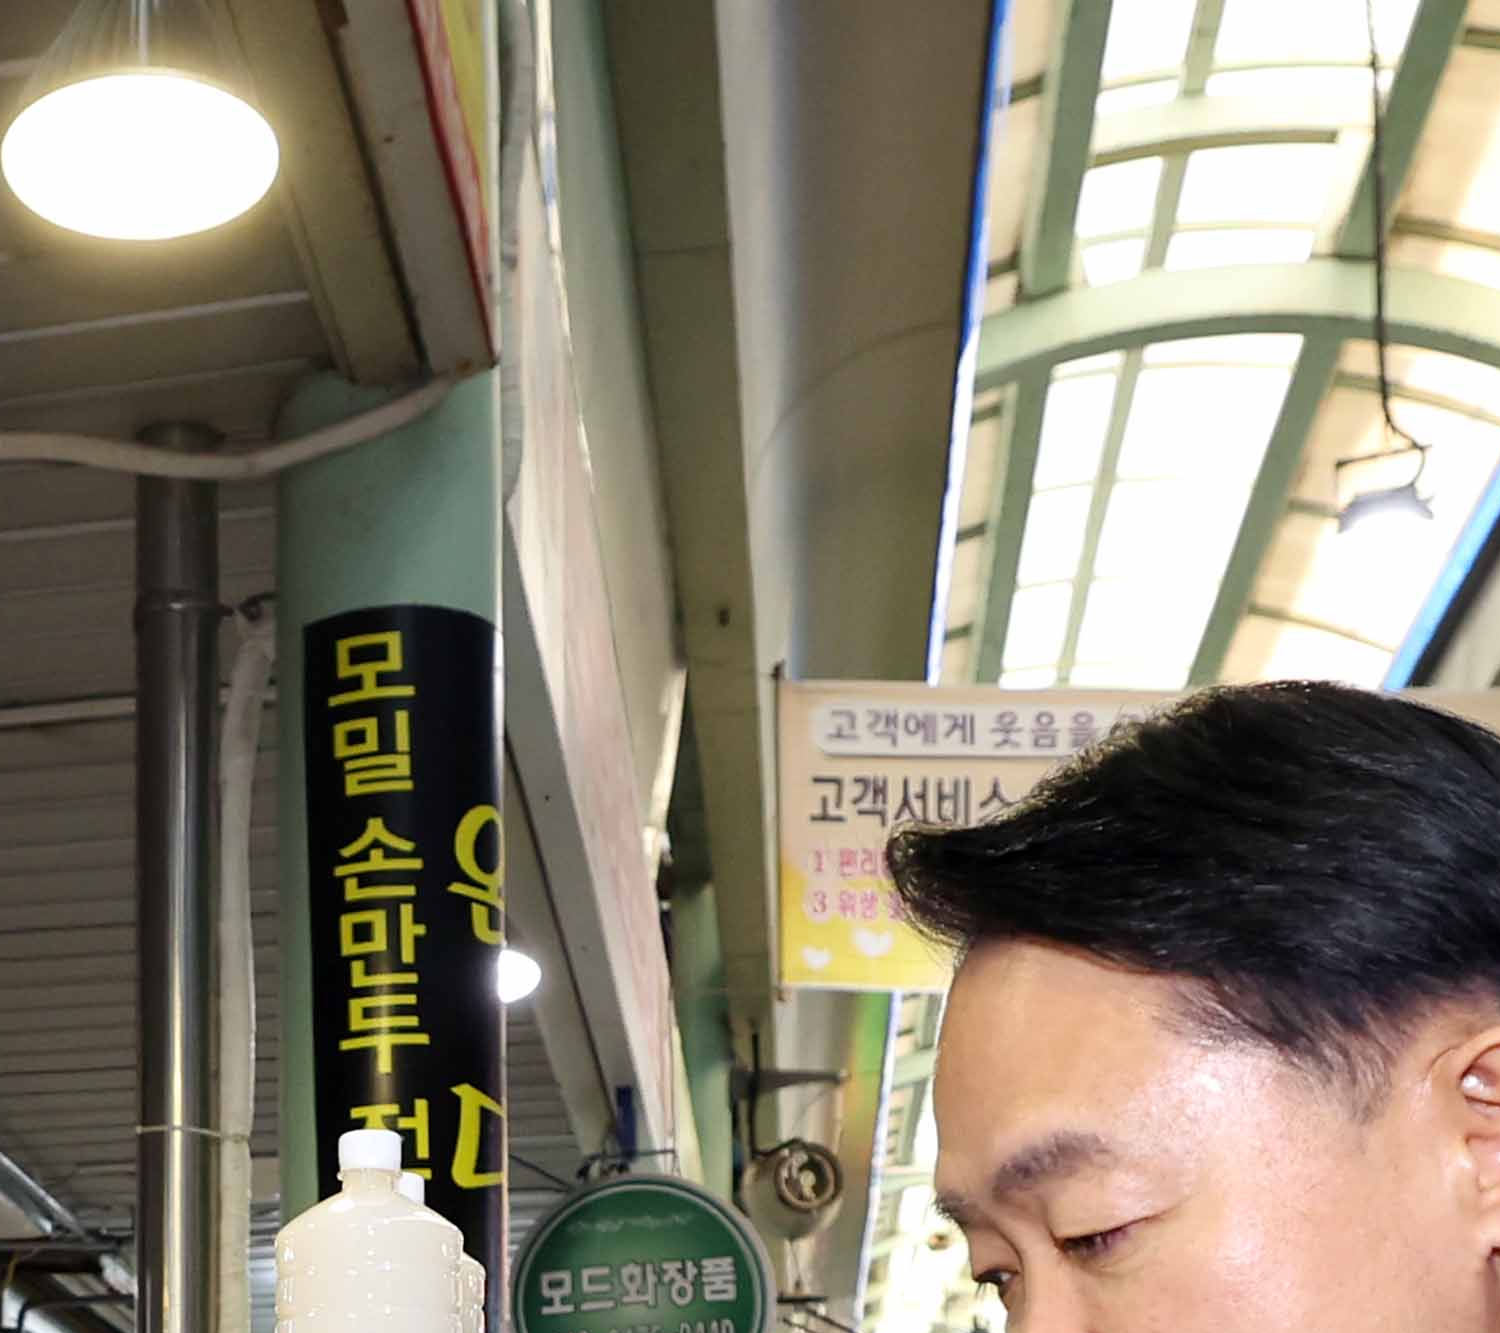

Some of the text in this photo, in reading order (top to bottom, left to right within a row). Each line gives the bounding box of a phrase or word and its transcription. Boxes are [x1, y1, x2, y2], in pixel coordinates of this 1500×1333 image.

[327, 630, 416, 797] 모밀
[825, 708, 1098, 749] 고객에게 웃음을
[333, 816, 430, 1075] 손만두
[540, 1256, 738, 1316] 모드화장품
